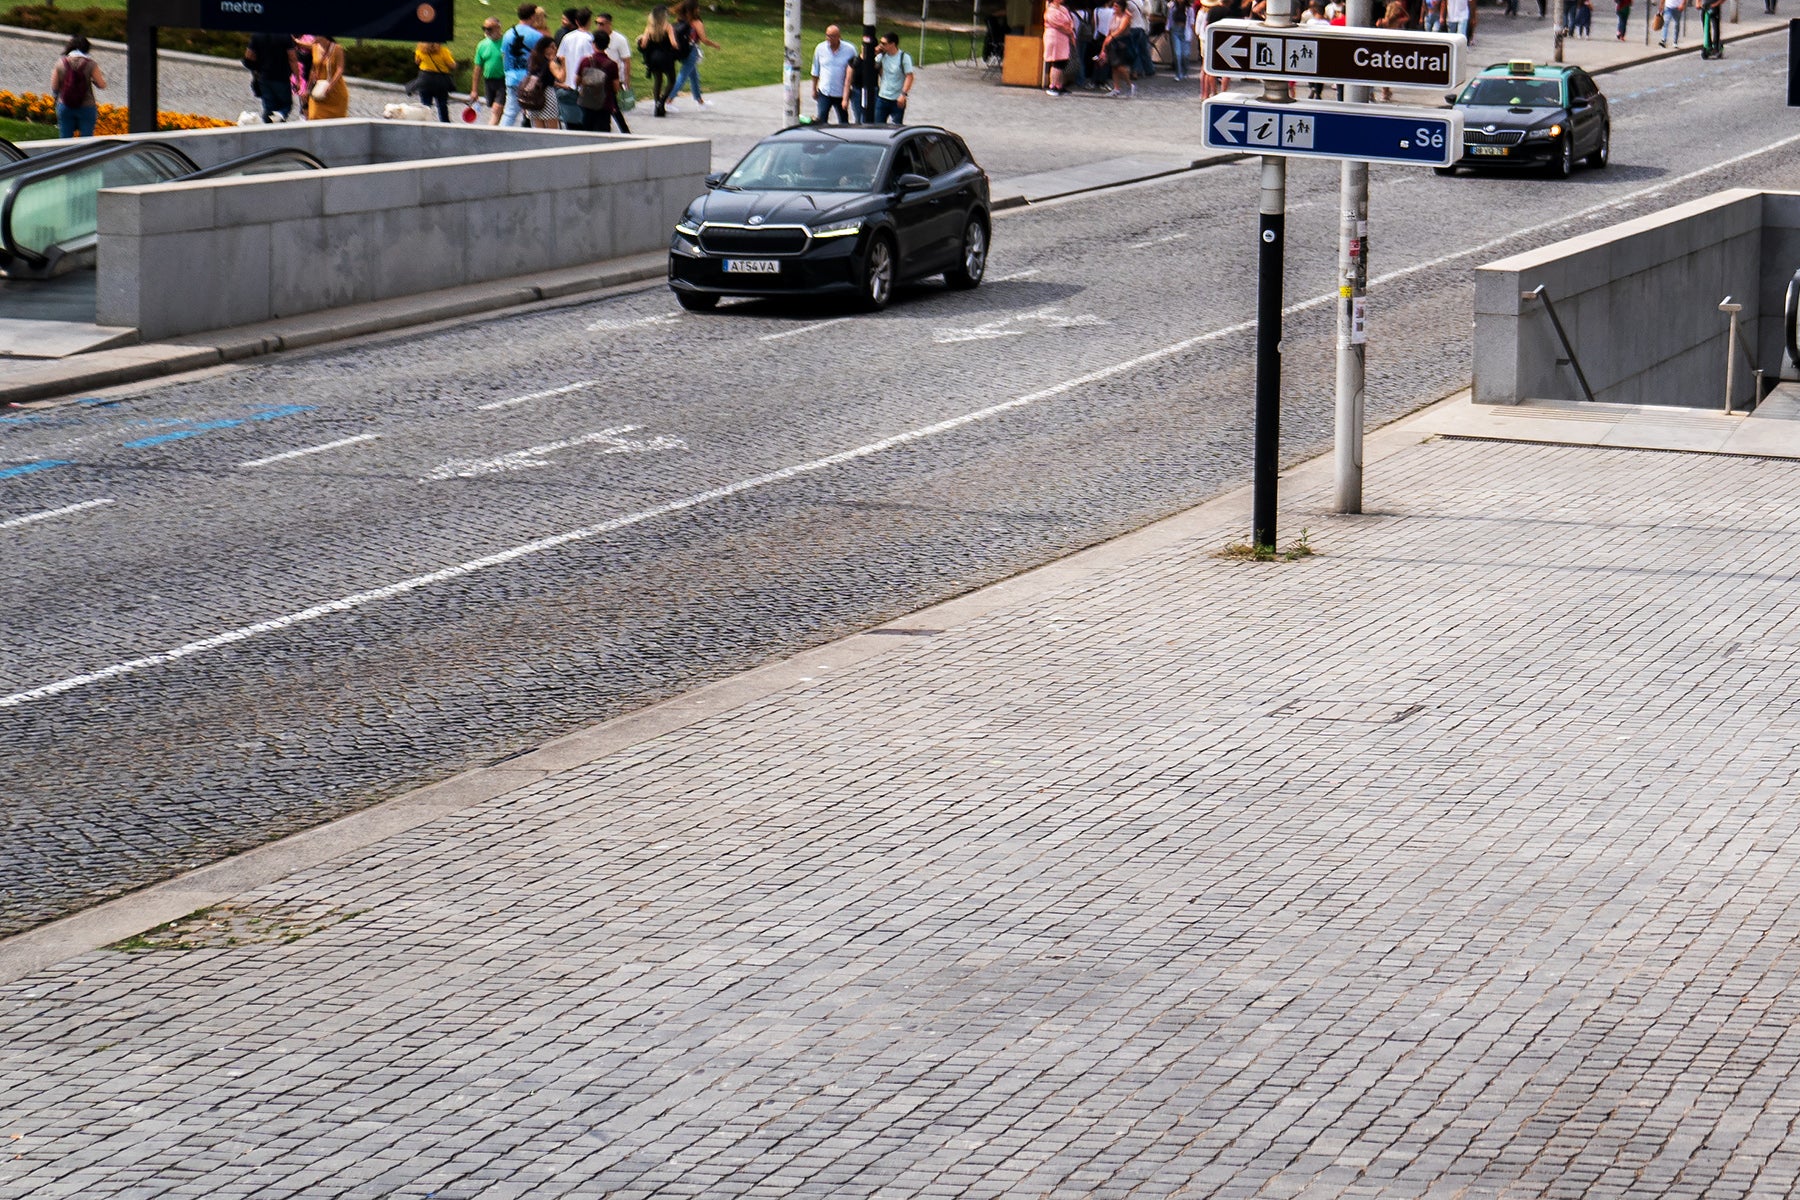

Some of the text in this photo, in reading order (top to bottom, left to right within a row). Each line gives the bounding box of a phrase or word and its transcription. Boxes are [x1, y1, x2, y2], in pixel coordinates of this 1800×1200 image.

[220, 0, 263, 15] metro
[1353, 47, 1448, 72] Catedral
[1415, 127, 1444, 148] Sé
